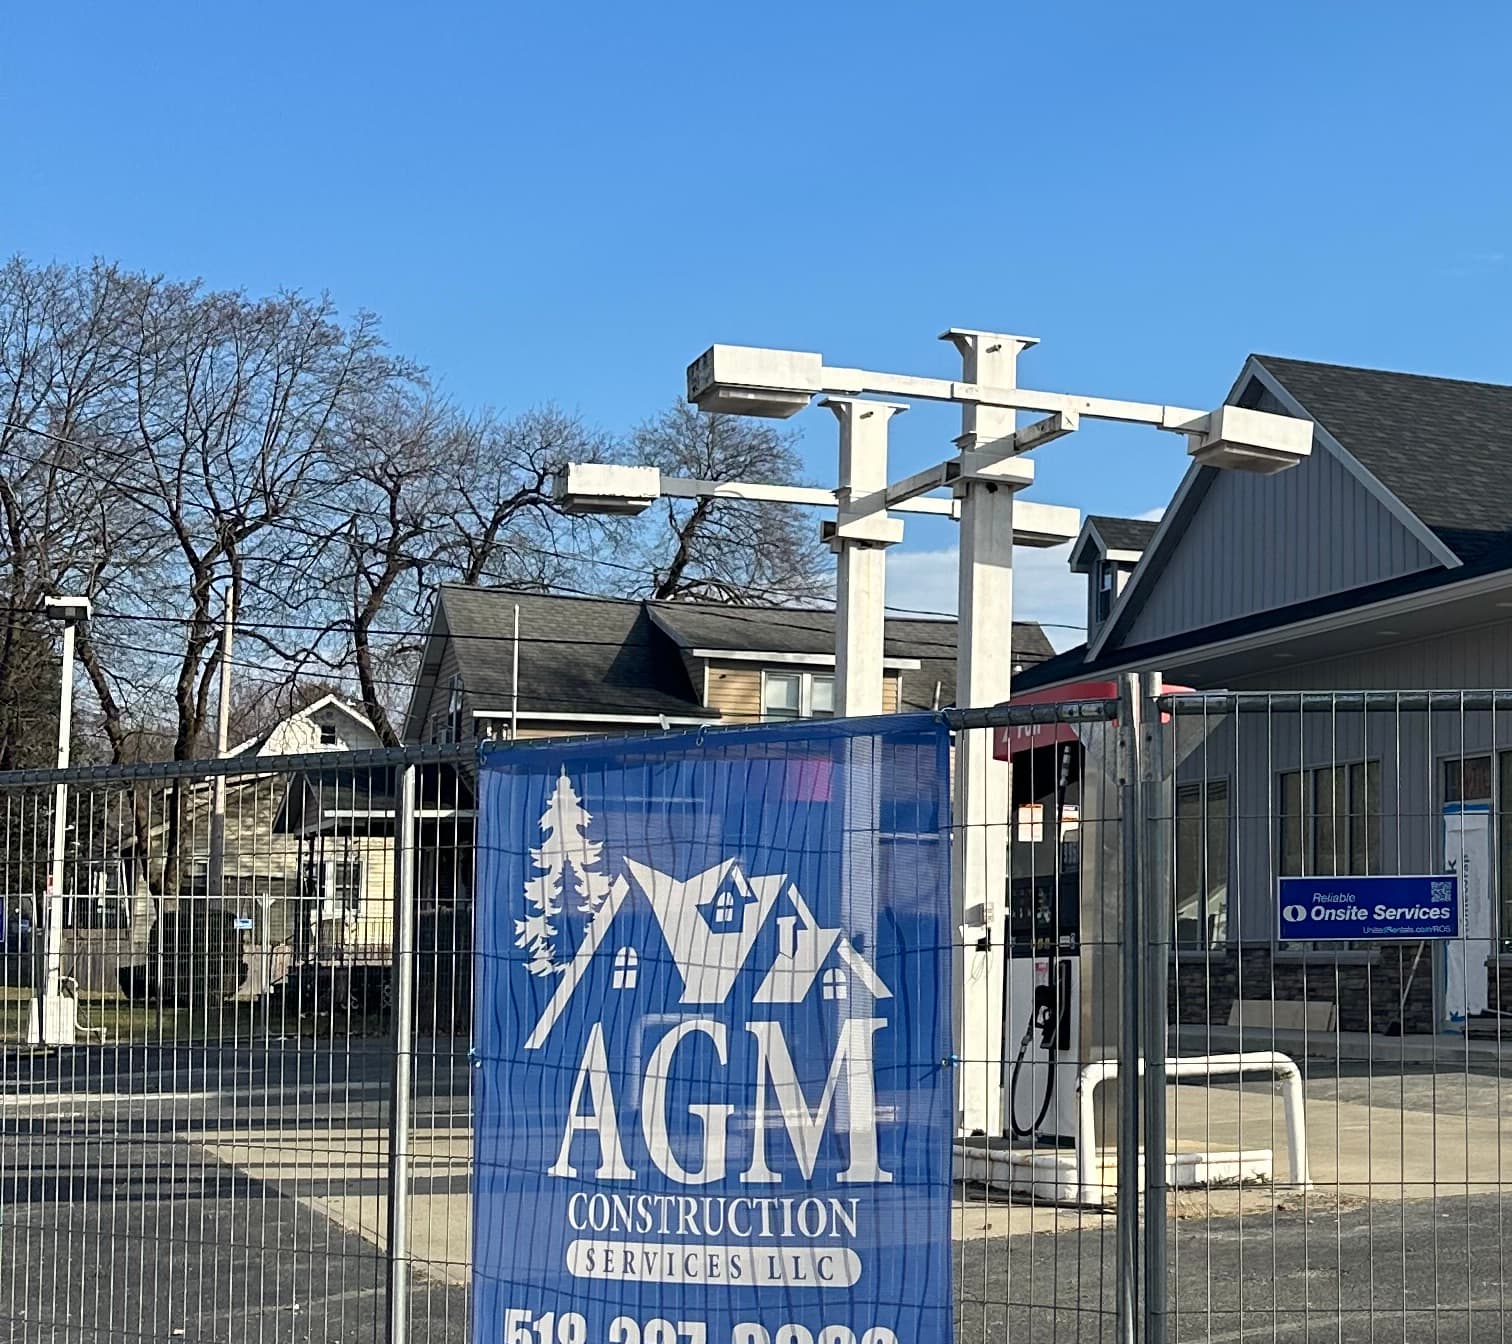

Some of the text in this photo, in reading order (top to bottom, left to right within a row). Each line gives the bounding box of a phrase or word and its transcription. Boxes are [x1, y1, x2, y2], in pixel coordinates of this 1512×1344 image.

[1311, 904, 1451, 921] Onsite Services
[1312, 892, 1356, 903] Reliable
[547, 1018, 893, 1185] AGM
[568, 1192, 861, 1238] CONSTRUCTION
[585, 1247, 834, 1281] SERVICES LLC
